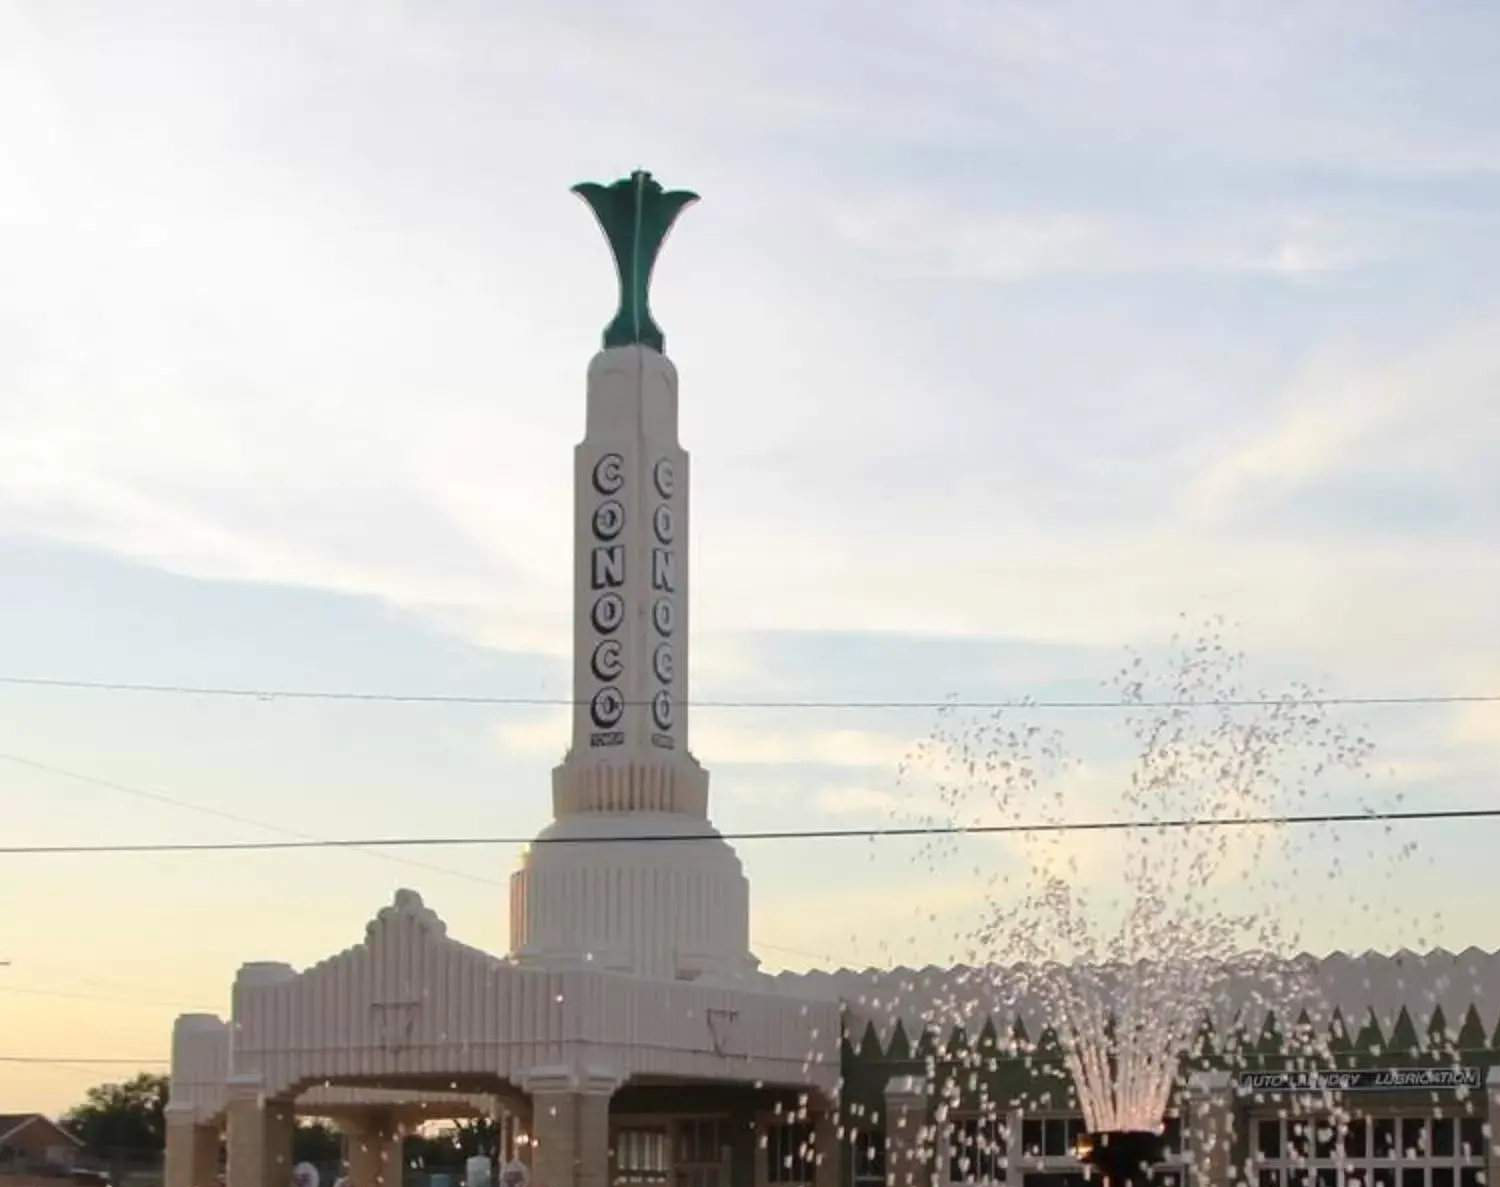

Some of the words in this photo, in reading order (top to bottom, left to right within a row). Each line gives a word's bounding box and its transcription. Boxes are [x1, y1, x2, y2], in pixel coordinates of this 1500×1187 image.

[590, 453, 625, 729] CONOCO
[652, 456, 675, 731] CONOCO
[1242, 1074, 1281, 1088] AUTO
[1375, 1070, 1477, 1085] LUBRICATION
